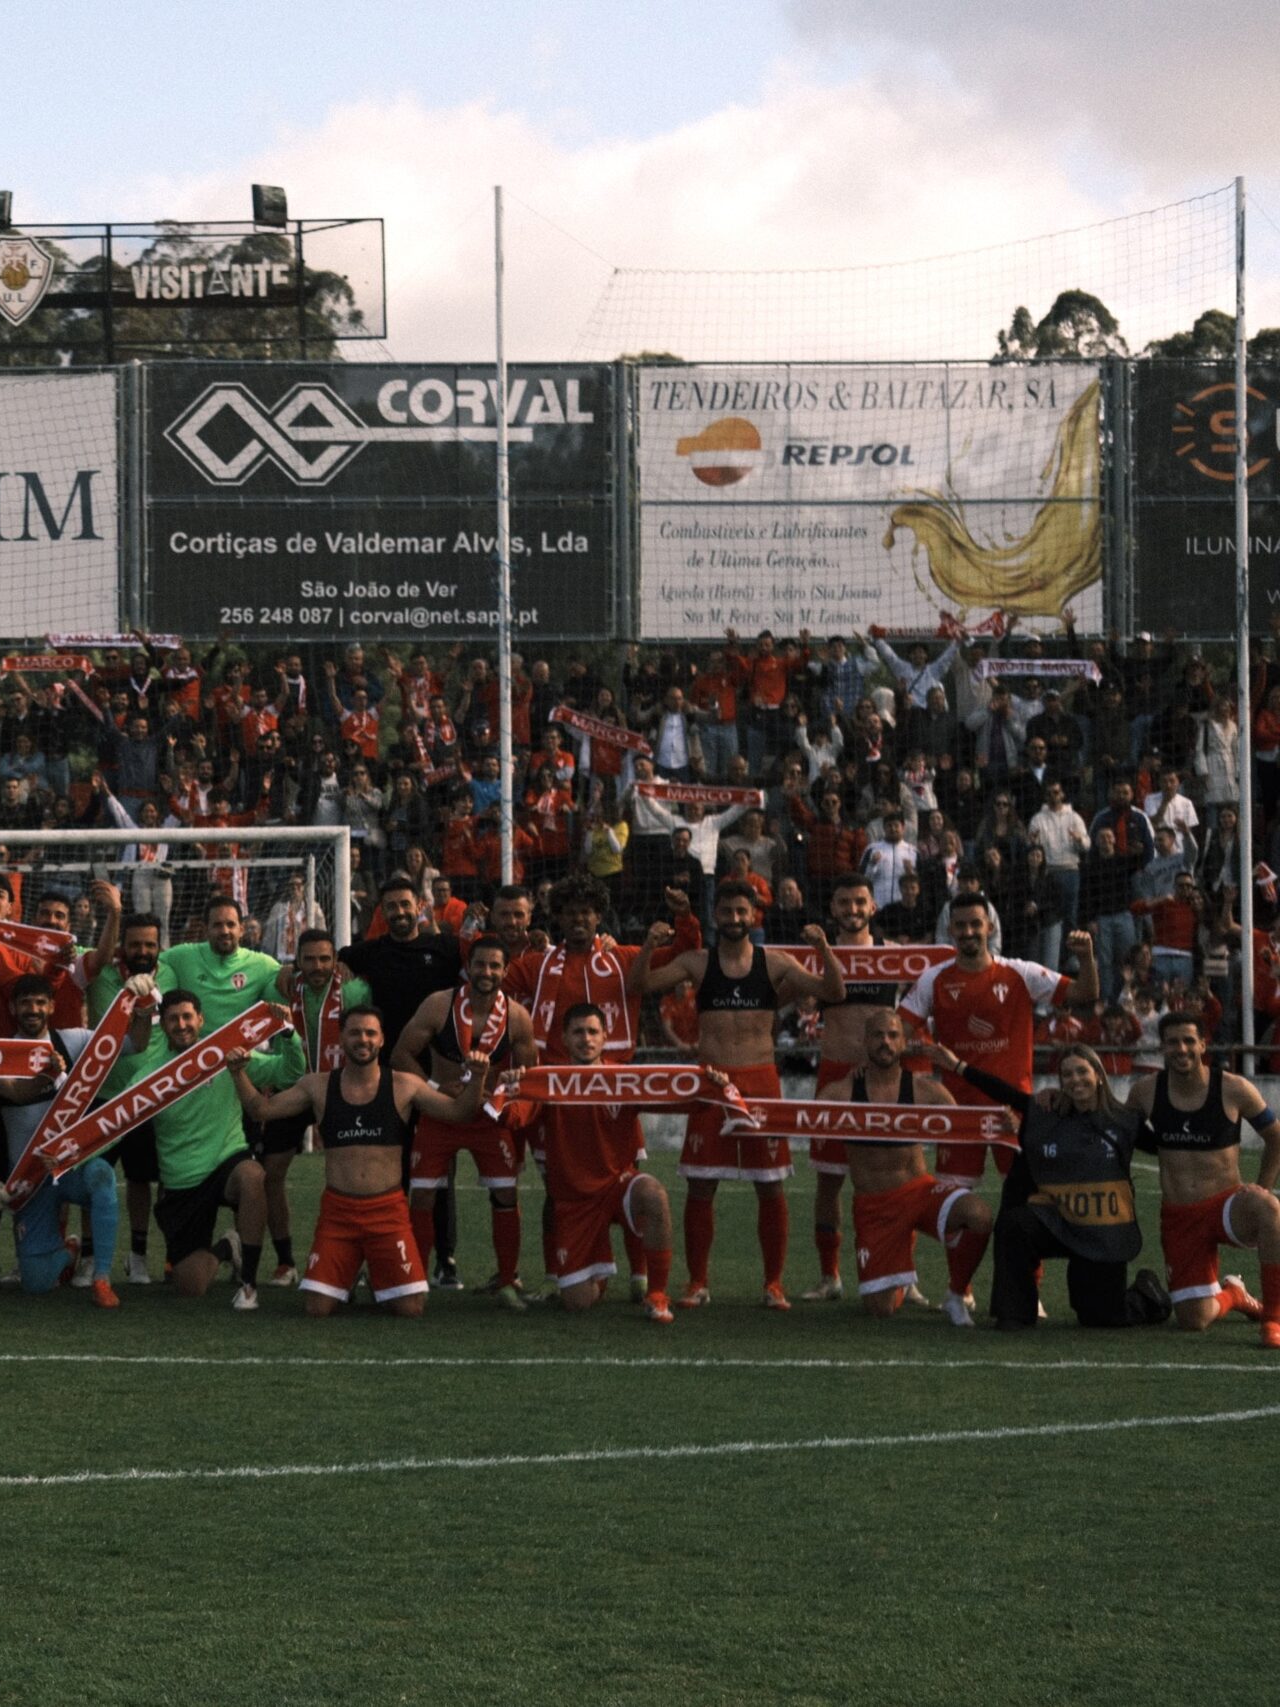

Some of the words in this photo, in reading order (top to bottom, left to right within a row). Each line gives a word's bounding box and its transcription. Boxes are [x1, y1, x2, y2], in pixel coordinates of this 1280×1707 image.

[377, 378, 594, 424] CORVAL
[650, 380, 819, 411] TENDEIROS
[828, 380, 851, 411] &
[782, 443, 915, 466] REPSOL
[169, 531, 278, 559] Cortiças
[286, 532, 317, 554] de
[325, 532, 447, 554] Valdemar
[541, 531, 589, 554] Lda
[301, 580, 336, 598] São
[343, 580, 389, 600] João
[396, 581, 420, 598] de
[426, 582, 458, 598] Ver
[220, 607, 254, 625] 256
[260, 607, 294, 625] 248
[299, 607, 333, 625] 087
[350, 607, 539, 629] corval@net.sap.pt
[15, 656, 74, 669] MARCO
[666, 787, 733, 801] MARCO
[713, 998, 761, 1008] CATAPULT
[96, 1045, 225, 1137] MARCO
[547, 1072, 701, 1097] MARCO
[337, 1126, 383, 1140] CATAPULT
[795, 1109, 953, 1136] MARCO
[1162, 1132, 1212, 1144] CATAPULT
[1042, 1144, 1058, 1159] 16
[396, 1239, 408, 1262] 7
